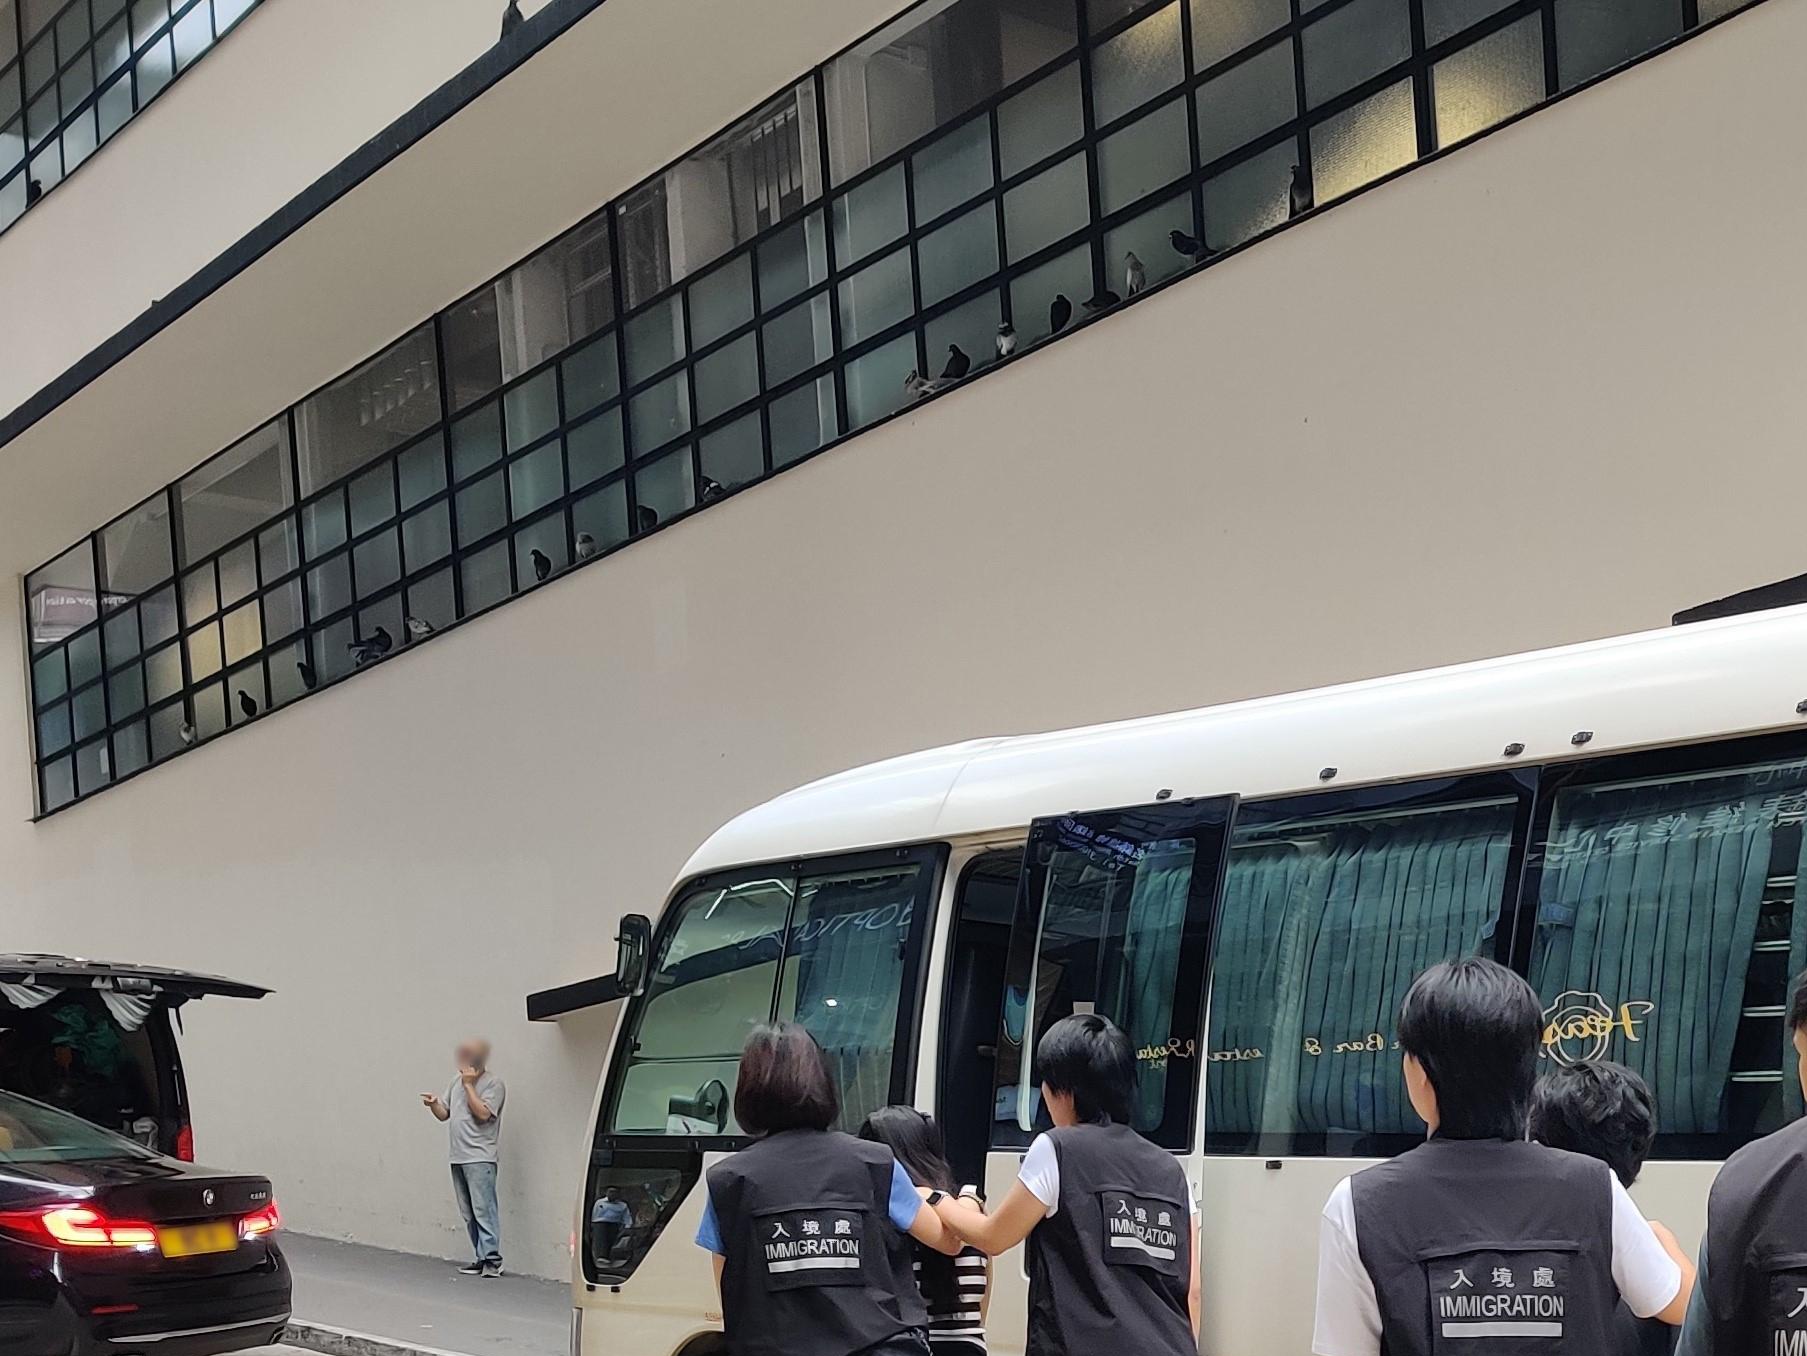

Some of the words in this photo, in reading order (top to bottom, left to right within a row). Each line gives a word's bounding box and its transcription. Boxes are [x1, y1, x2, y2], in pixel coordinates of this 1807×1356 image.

[771, 1219, 852, 1239] 入境處
[764, 1238, 860, 1261] IMMIGRATION
[1449, 1266, 1556, 1290] 入境處
[1440, 1293, 1565, 1318] IMMIGRATION
